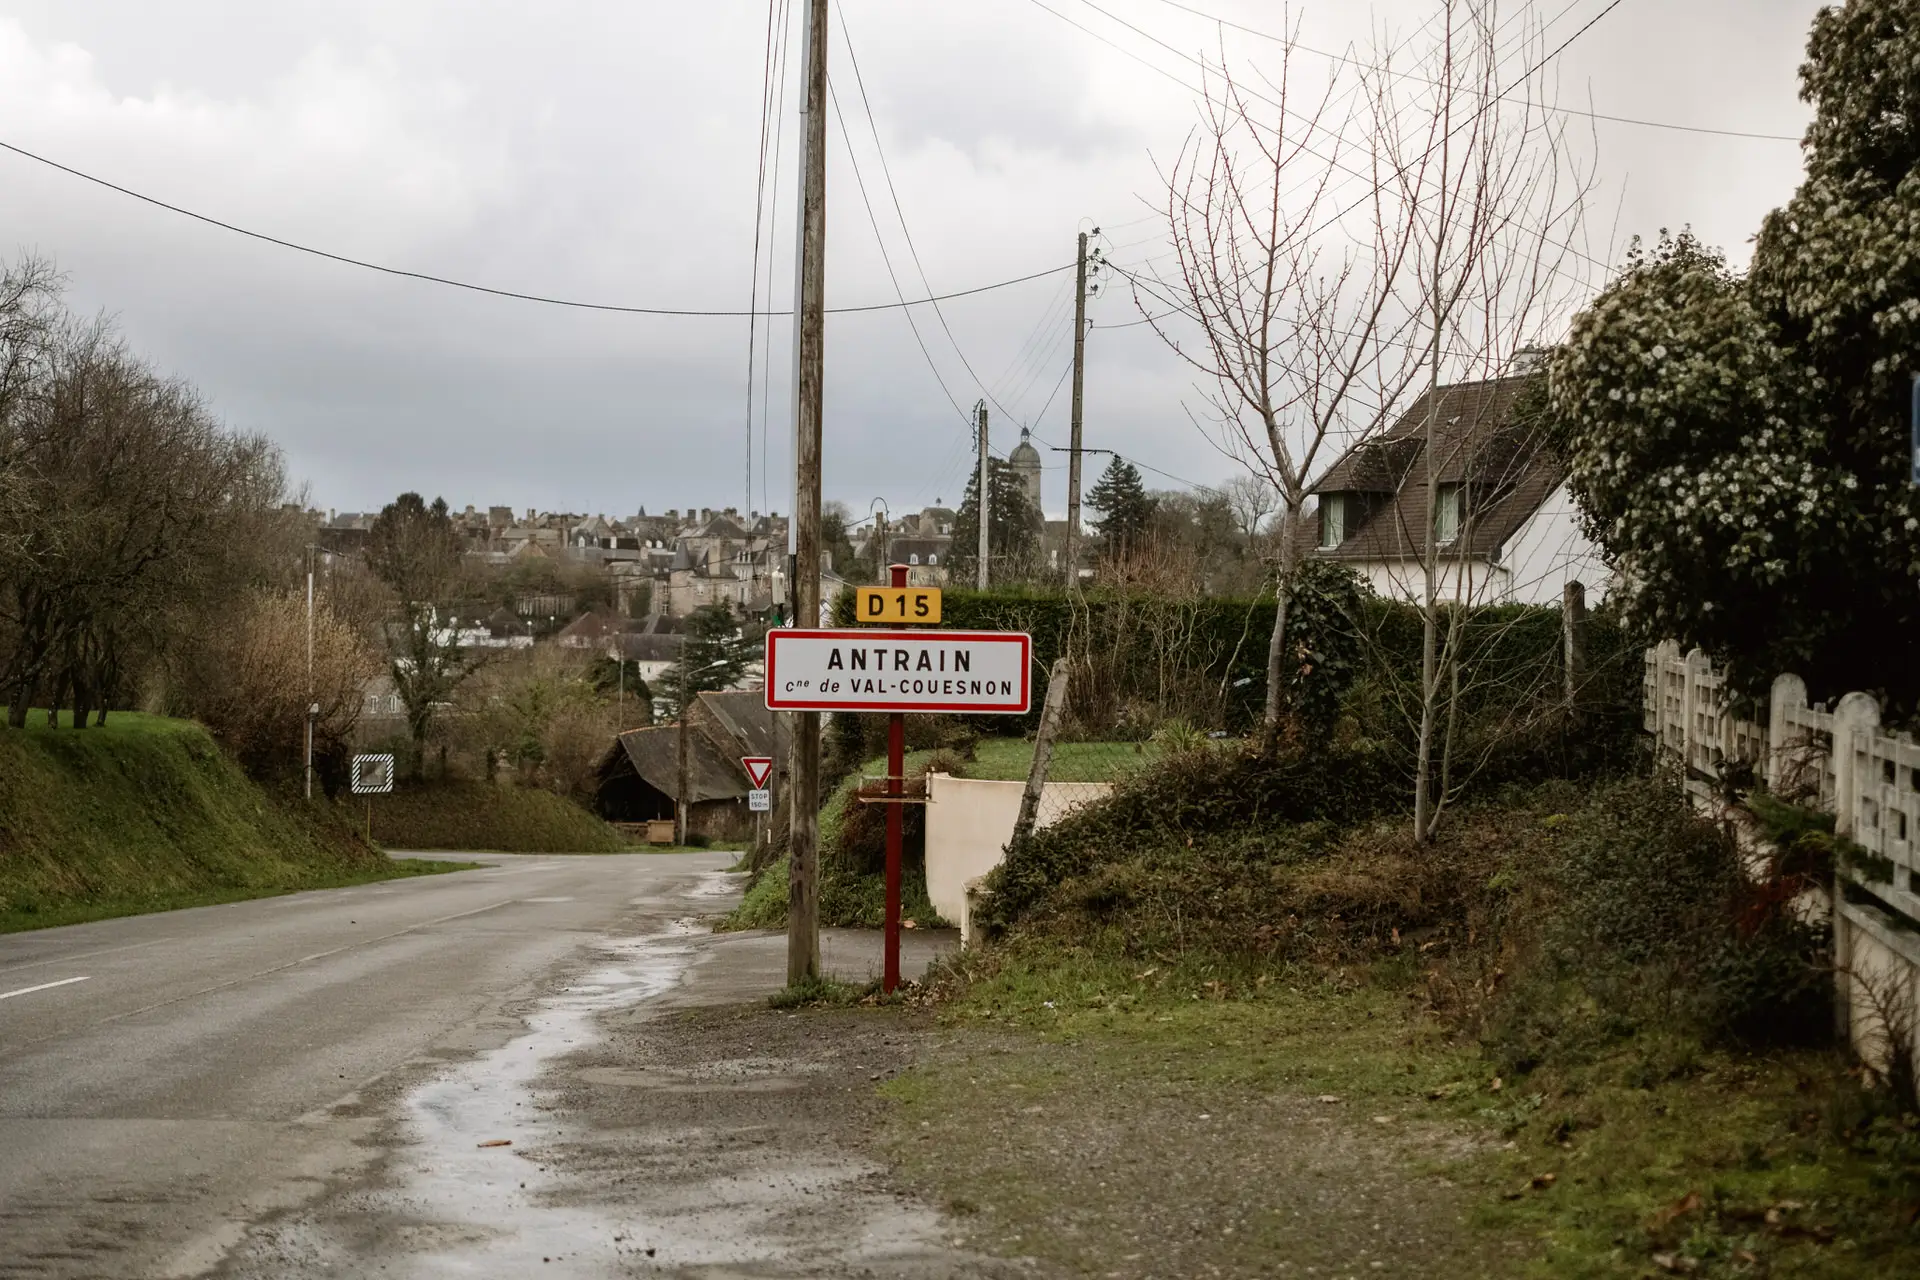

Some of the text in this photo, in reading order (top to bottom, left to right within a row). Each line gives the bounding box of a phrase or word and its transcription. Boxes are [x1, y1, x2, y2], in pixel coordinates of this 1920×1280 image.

[868, 595, 929, 617] D 15
[827, 648, 970, 672] ANTRAIN
[820, 679, 840, 693] de
[851, 679, 1012, 695] VAL-COUESNON
